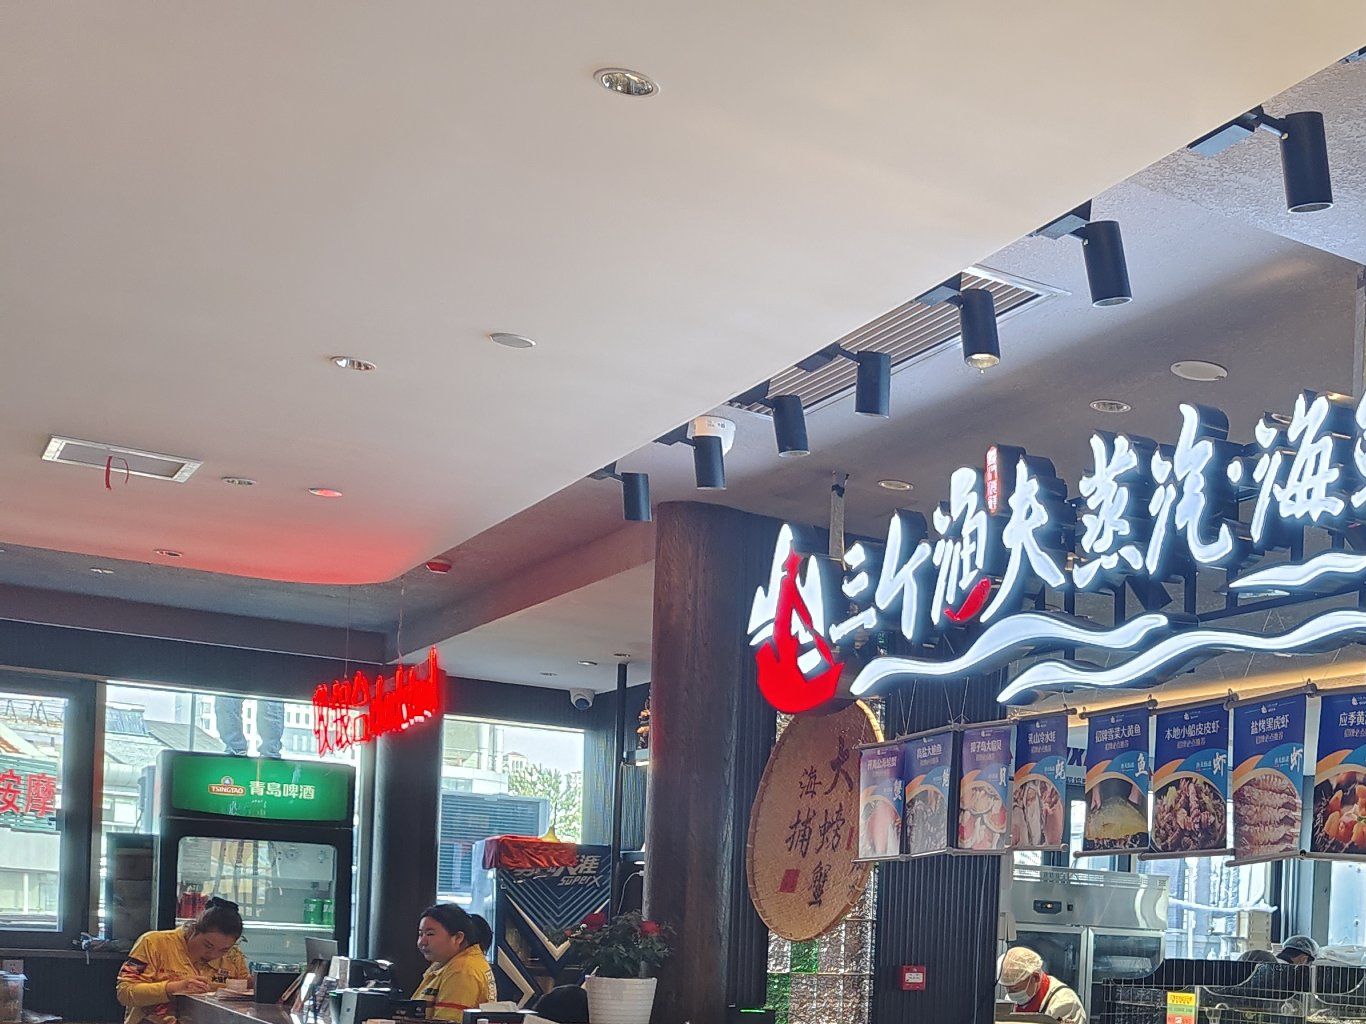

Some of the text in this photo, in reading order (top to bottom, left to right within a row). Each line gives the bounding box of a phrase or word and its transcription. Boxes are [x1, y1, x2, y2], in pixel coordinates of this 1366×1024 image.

[1135, 753, 1149, 777] 鱼
[1213, 752, 1227, 777] 虾
[249, 780, 315, 800] 青岛啤酒
